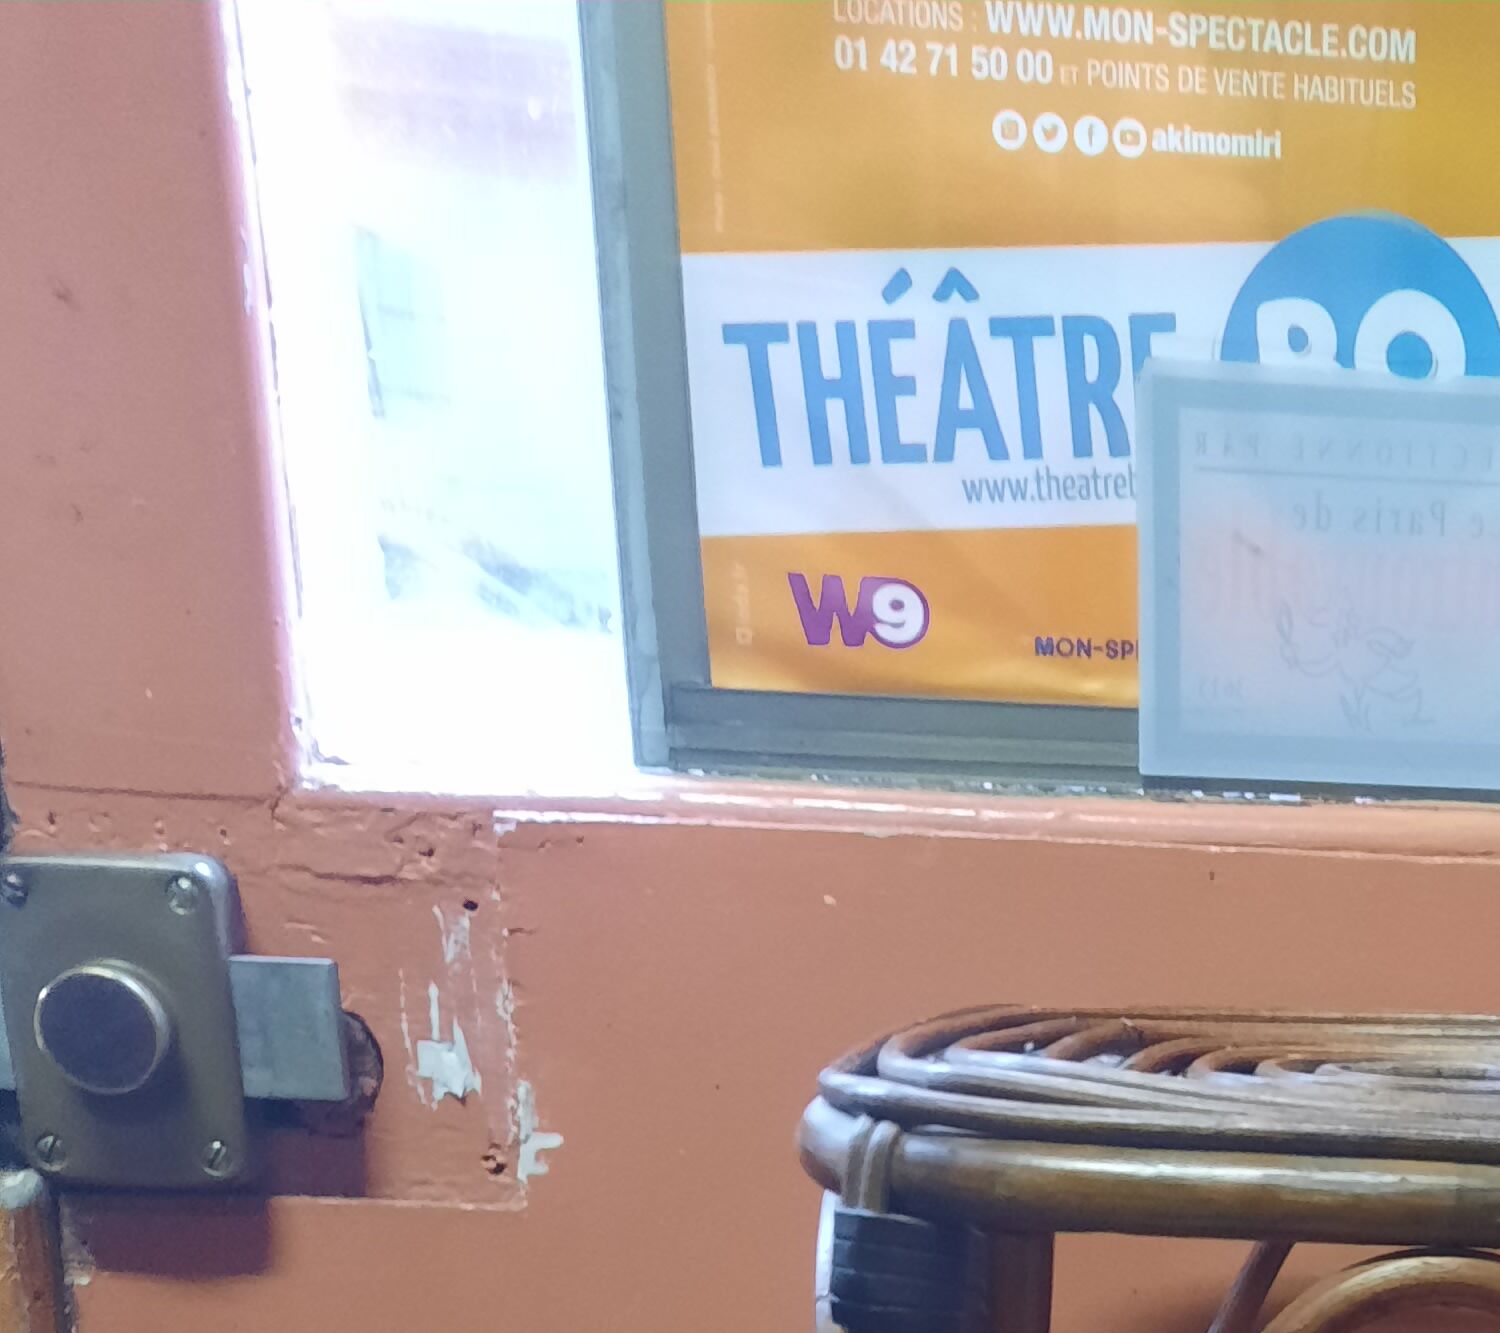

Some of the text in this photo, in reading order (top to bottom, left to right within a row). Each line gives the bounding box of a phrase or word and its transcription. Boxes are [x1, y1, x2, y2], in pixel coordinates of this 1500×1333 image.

[833, 0, 964, 33] LOCATIONS
[985, 1, 1416, 63] WWW.MON-SPECTACLE.COM
[833, 34, 867, 71] 01
[880, 38, 918, 74] 42
[928, 41, 959, 77] 71
[971, 44, 1008, 81] 50
[1016, 47, 1053, 84] 00
[1086, 59, 1170, 94] POINTS
[1178, 65, 1207, 95] DE
[1213, 67, 1286, 100] VENTE
[1293, 73, 1416, 110] HABITUELS
[1152, 122, 1282, 160] akimomiri
[788, 572, 930, 649] W9
[1034, 635, 1139, 664] MON-SP
